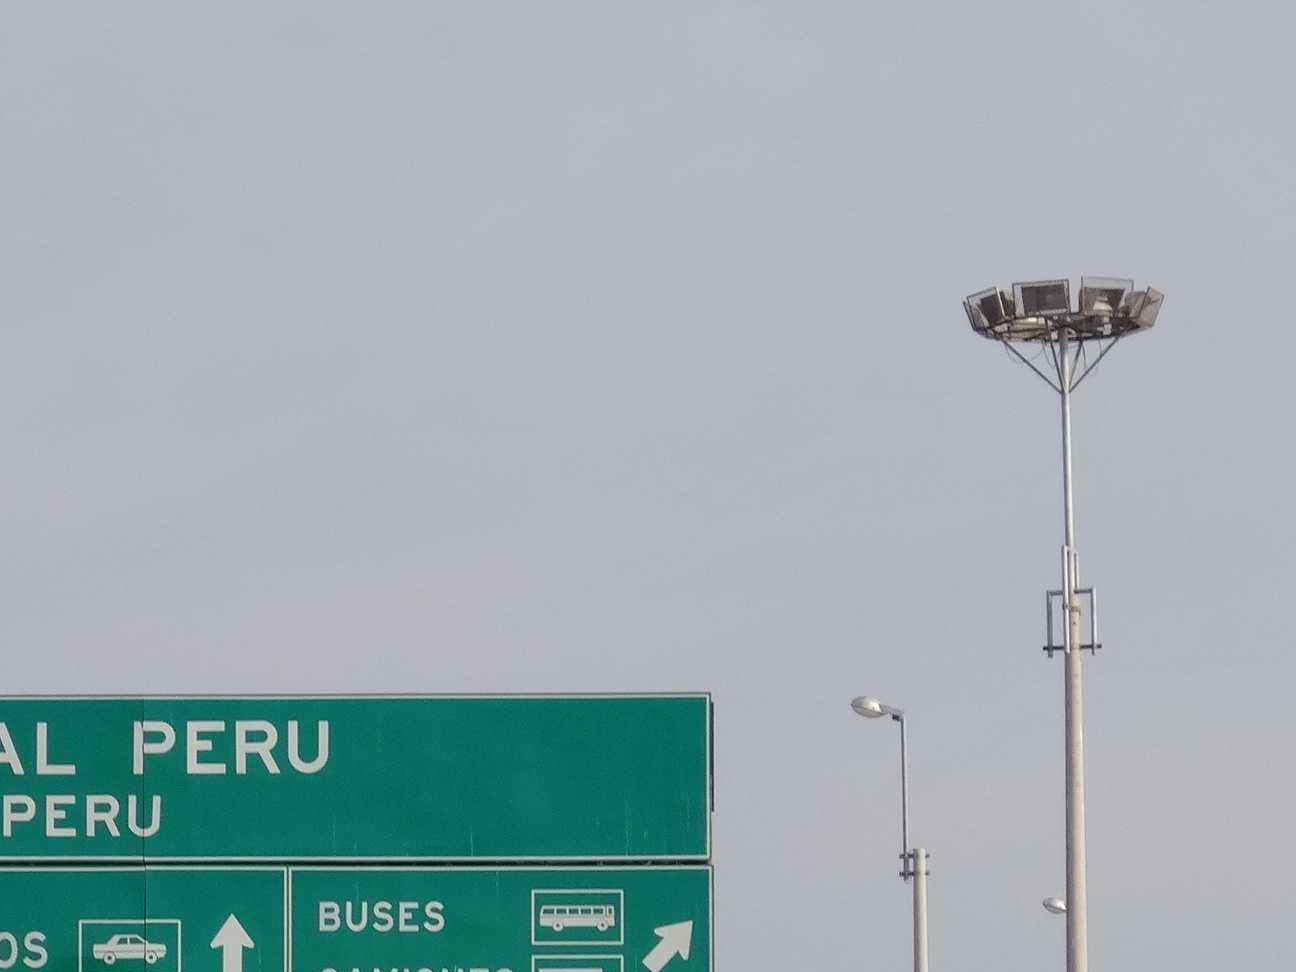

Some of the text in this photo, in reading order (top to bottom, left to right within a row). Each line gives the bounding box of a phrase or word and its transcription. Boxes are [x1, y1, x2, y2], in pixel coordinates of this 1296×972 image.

[132, 719, 331, 776] PERU
[2, 793, 163, 838] PERU
[318, 900, 446, 933] BUSES
